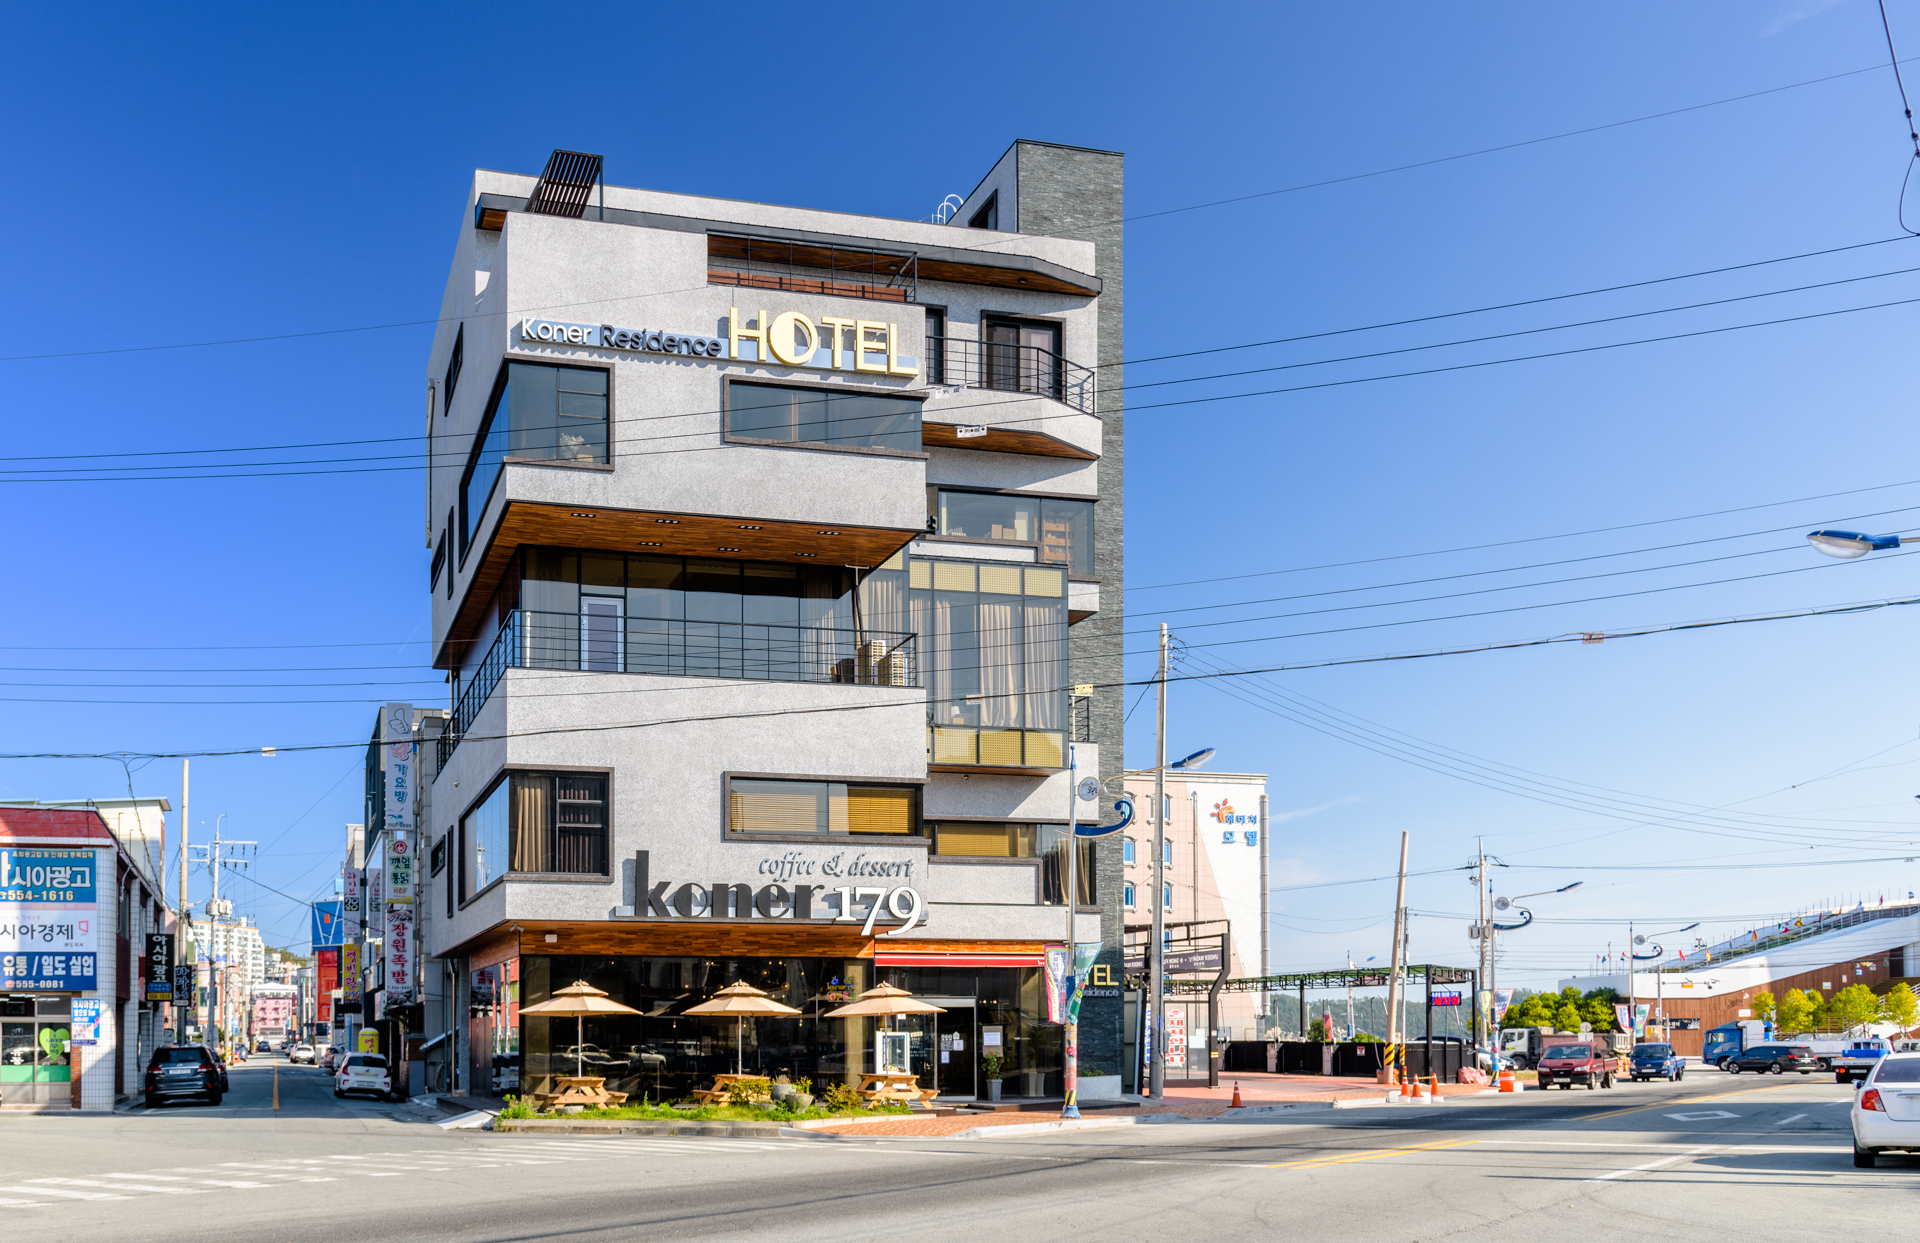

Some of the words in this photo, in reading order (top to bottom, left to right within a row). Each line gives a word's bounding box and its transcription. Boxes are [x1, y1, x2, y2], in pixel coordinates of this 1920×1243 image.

[521, 317, 592, 344] Koner
[600, 324, 722, 357] Residence
[729, 307, 919, 376] HOTEL
[394, 764, 407, 804] 가요방
[1223, 831, 1258, 845] 모텔
[759, 851, 817, 882] coffee
[822, 853, 843, 877] &
[848, 853, 914, 877] dessert
[347, 872, 357, 895] 라이브
[392, 872, 409, 884] 통닭
[8, 890, 74, 901] 554-1616
[635, 850, 825, 918] koner
[834, 886, 922, 936] 179
[152, 935, 168, 983] 아시아광고
[391, 922, 408, 984] 장원족발
[3, 955, 27, 977] 유통
[41, 955, 66, 976] 일도
[69, 955, 94, 976] 실업
[15, 980, 64, 988] 555-0081
[1084, 988, 1119, 997] sidence
[829, 992, 856, 1001] OPEN
